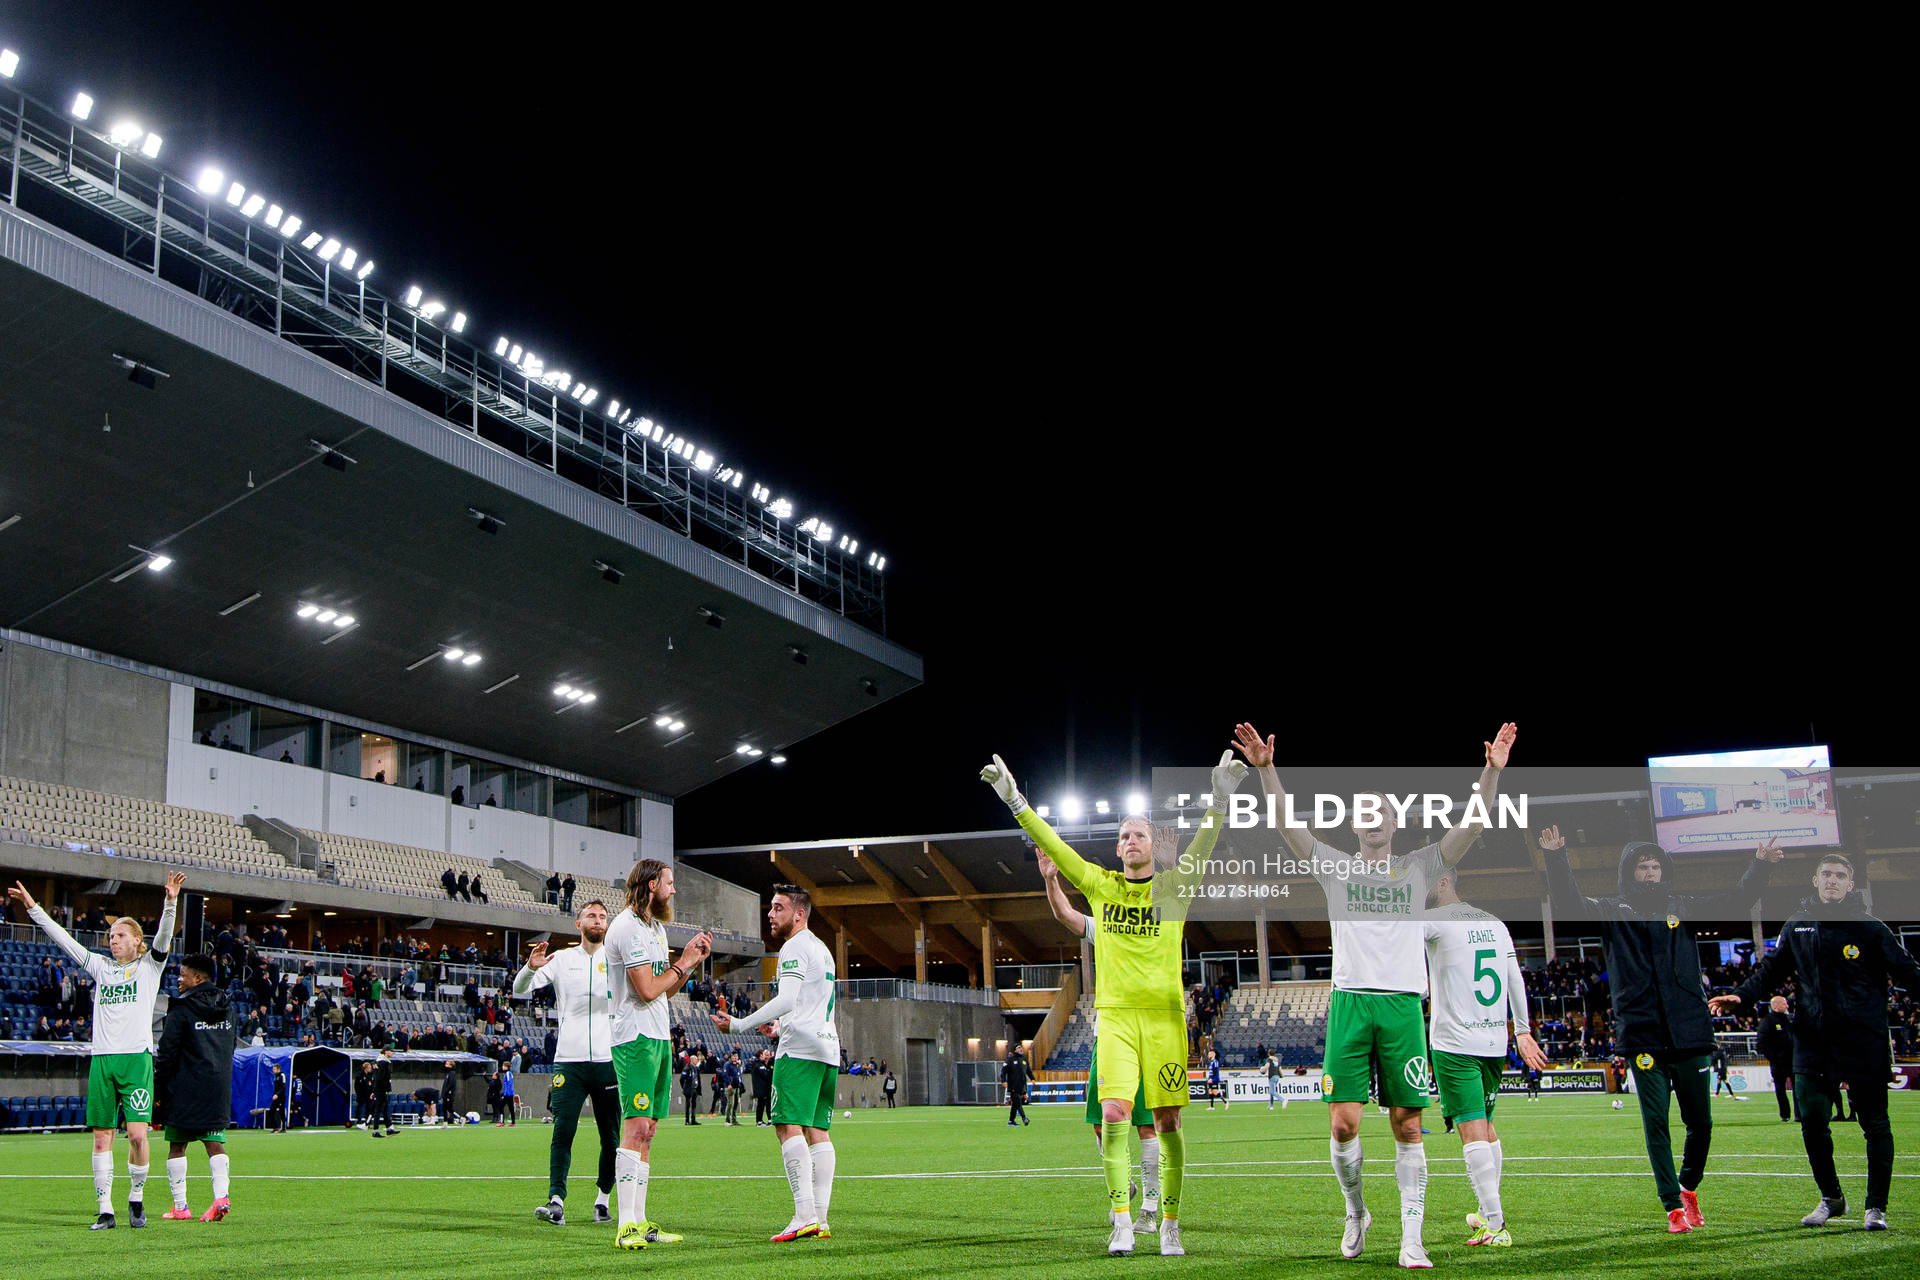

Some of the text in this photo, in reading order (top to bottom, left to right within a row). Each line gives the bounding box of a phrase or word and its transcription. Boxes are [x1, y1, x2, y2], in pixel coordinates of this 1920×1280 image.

[1347, 903, 1411, 914] CHOCOLATE
[1103, 923, 1160, 936] CHOCOLATE
[1467, 929, 1496, 944] JEAHZE
[1473, 949, 1502, 1007] 5
[1553, 1075, 1602, 1083] SNICKERI
[1553, 1081, 1602, 1089] PORTALEN
[1234, 1083, 1247, 1095] BT
[1251, 1082, 1309, 1095] Venilation
[785, 1158, 801, 1193] Clinton
